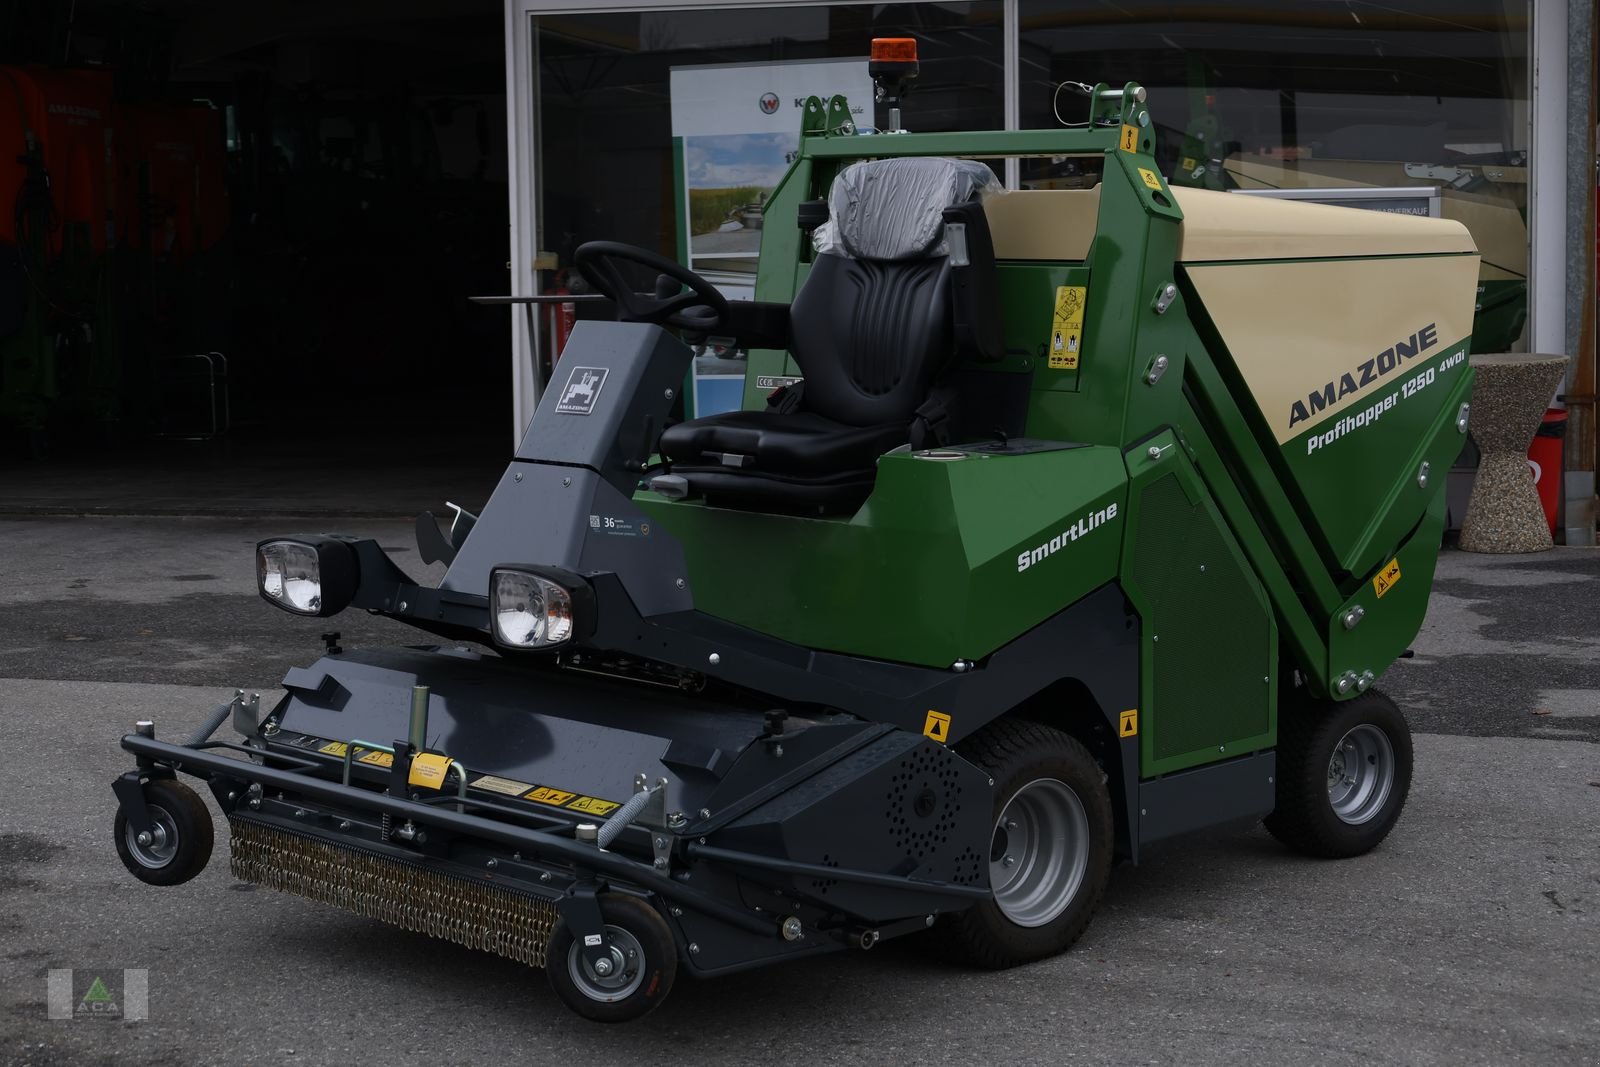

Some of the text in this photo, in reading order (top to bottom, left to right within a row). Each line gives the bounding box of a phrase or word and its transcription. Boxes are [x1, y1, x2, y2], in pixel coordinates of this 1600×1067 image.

[1289, 323, 1437, 429] AMAZONE
[1307, 391, 1398, 455] Profihopper
[1401, 367, 1435, 399] 1250
[604, 517, 614, 528] 36
[1017, 502, 1118, 573] SmartLine
